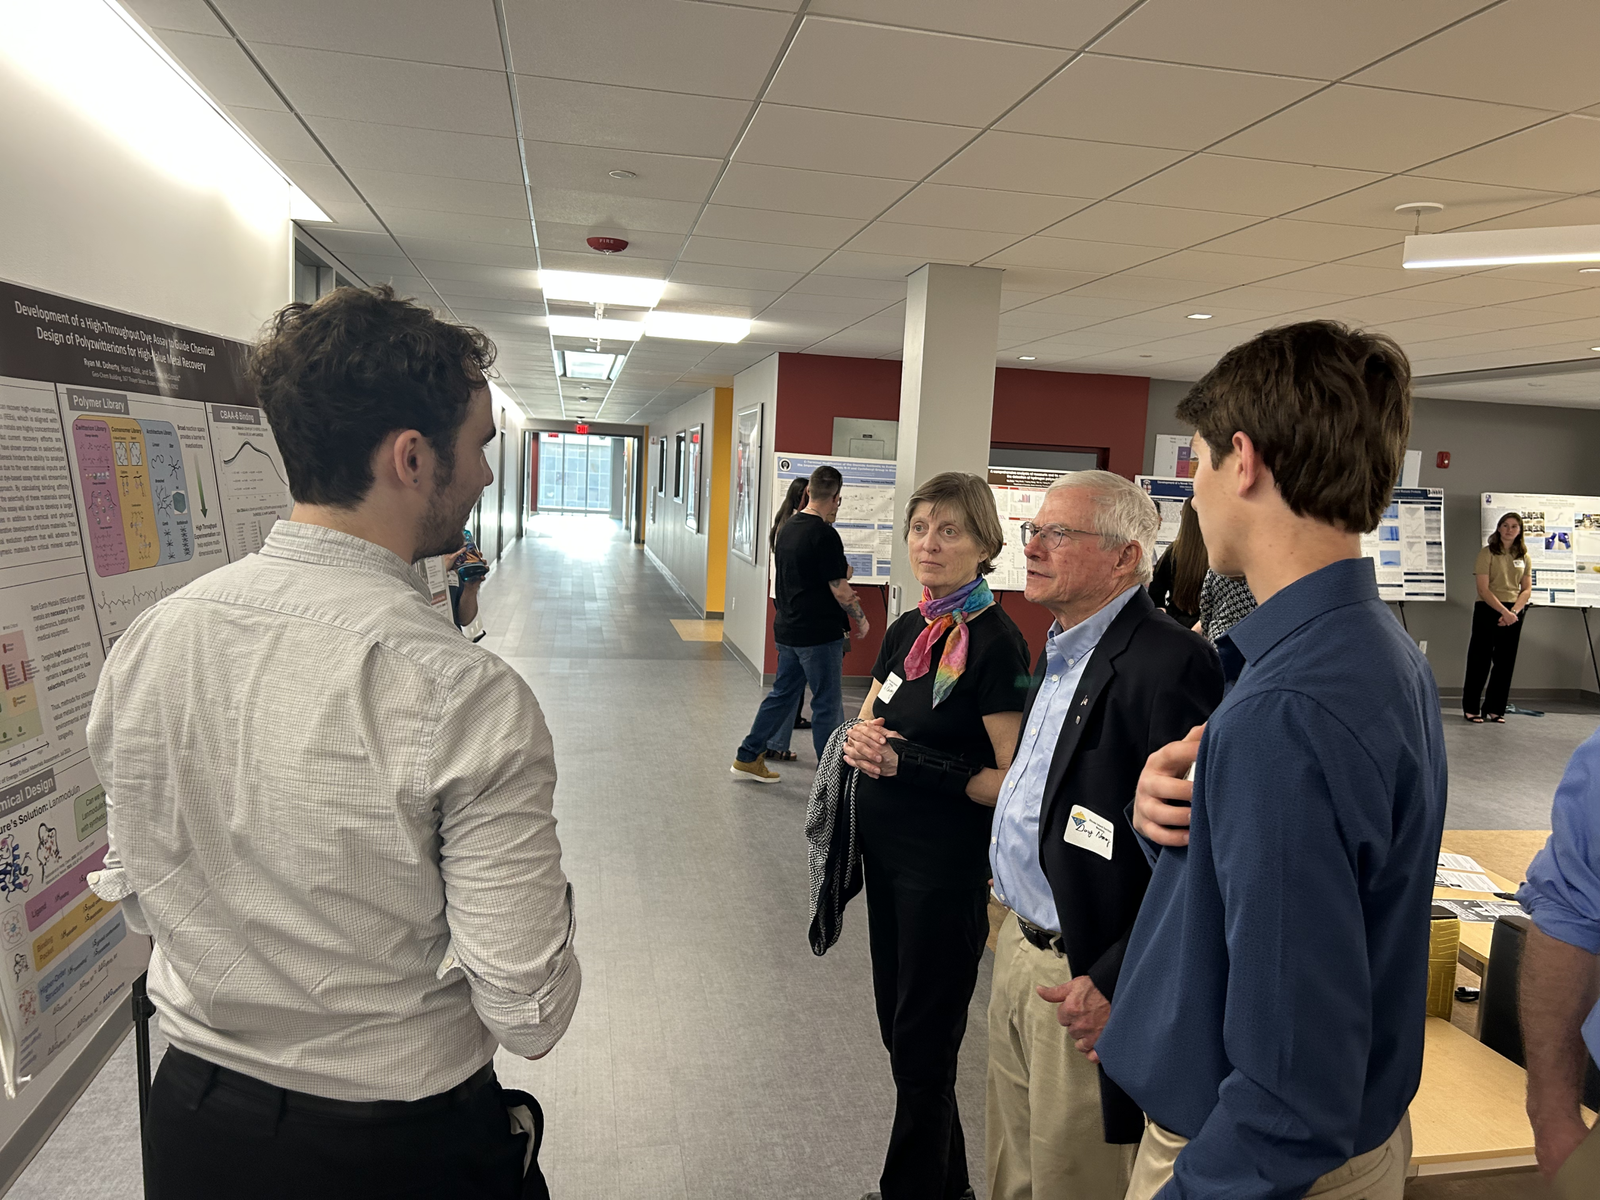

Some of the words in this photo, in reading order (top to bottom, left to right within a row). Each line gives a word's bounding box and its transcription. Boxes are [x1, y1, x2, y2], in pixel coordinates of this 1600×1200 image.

[15, 301, 70, 324] Development
[71, 314, 79, 326] of
[80, 318, 85, 328] a
[85, 317, 140, 341] High-Throughput
[140, 330, 152, 344] Dye
[153, 333, 168, 349] Assay
[174, 339, 190, 352] Guide
[190, 343, 215, 357] Chemical
[36, 326, 64, 345] Design
[65, 332, 74, 345] of
[76, 334, 127, 355] Polyzwitterions
[127, 344, 137, 357] for
[182, 357, 206, 373] Recovery
[84, 358, 95, 368] Ryan
[73, 395, 101, 409] Polymer
[103, 398, 124, 412] Library
[239, 412, 254, 423] Binding
[76, 424, 94, 432] Zwitterion
[577, 425, 588, 434] EXIT
[25, 778, 53, 799] Design
[19, 804, 48, 824] Solution:
[49, 785, 80, 809] Lanmodulin
[31, 903, 47, 918] Ligand
